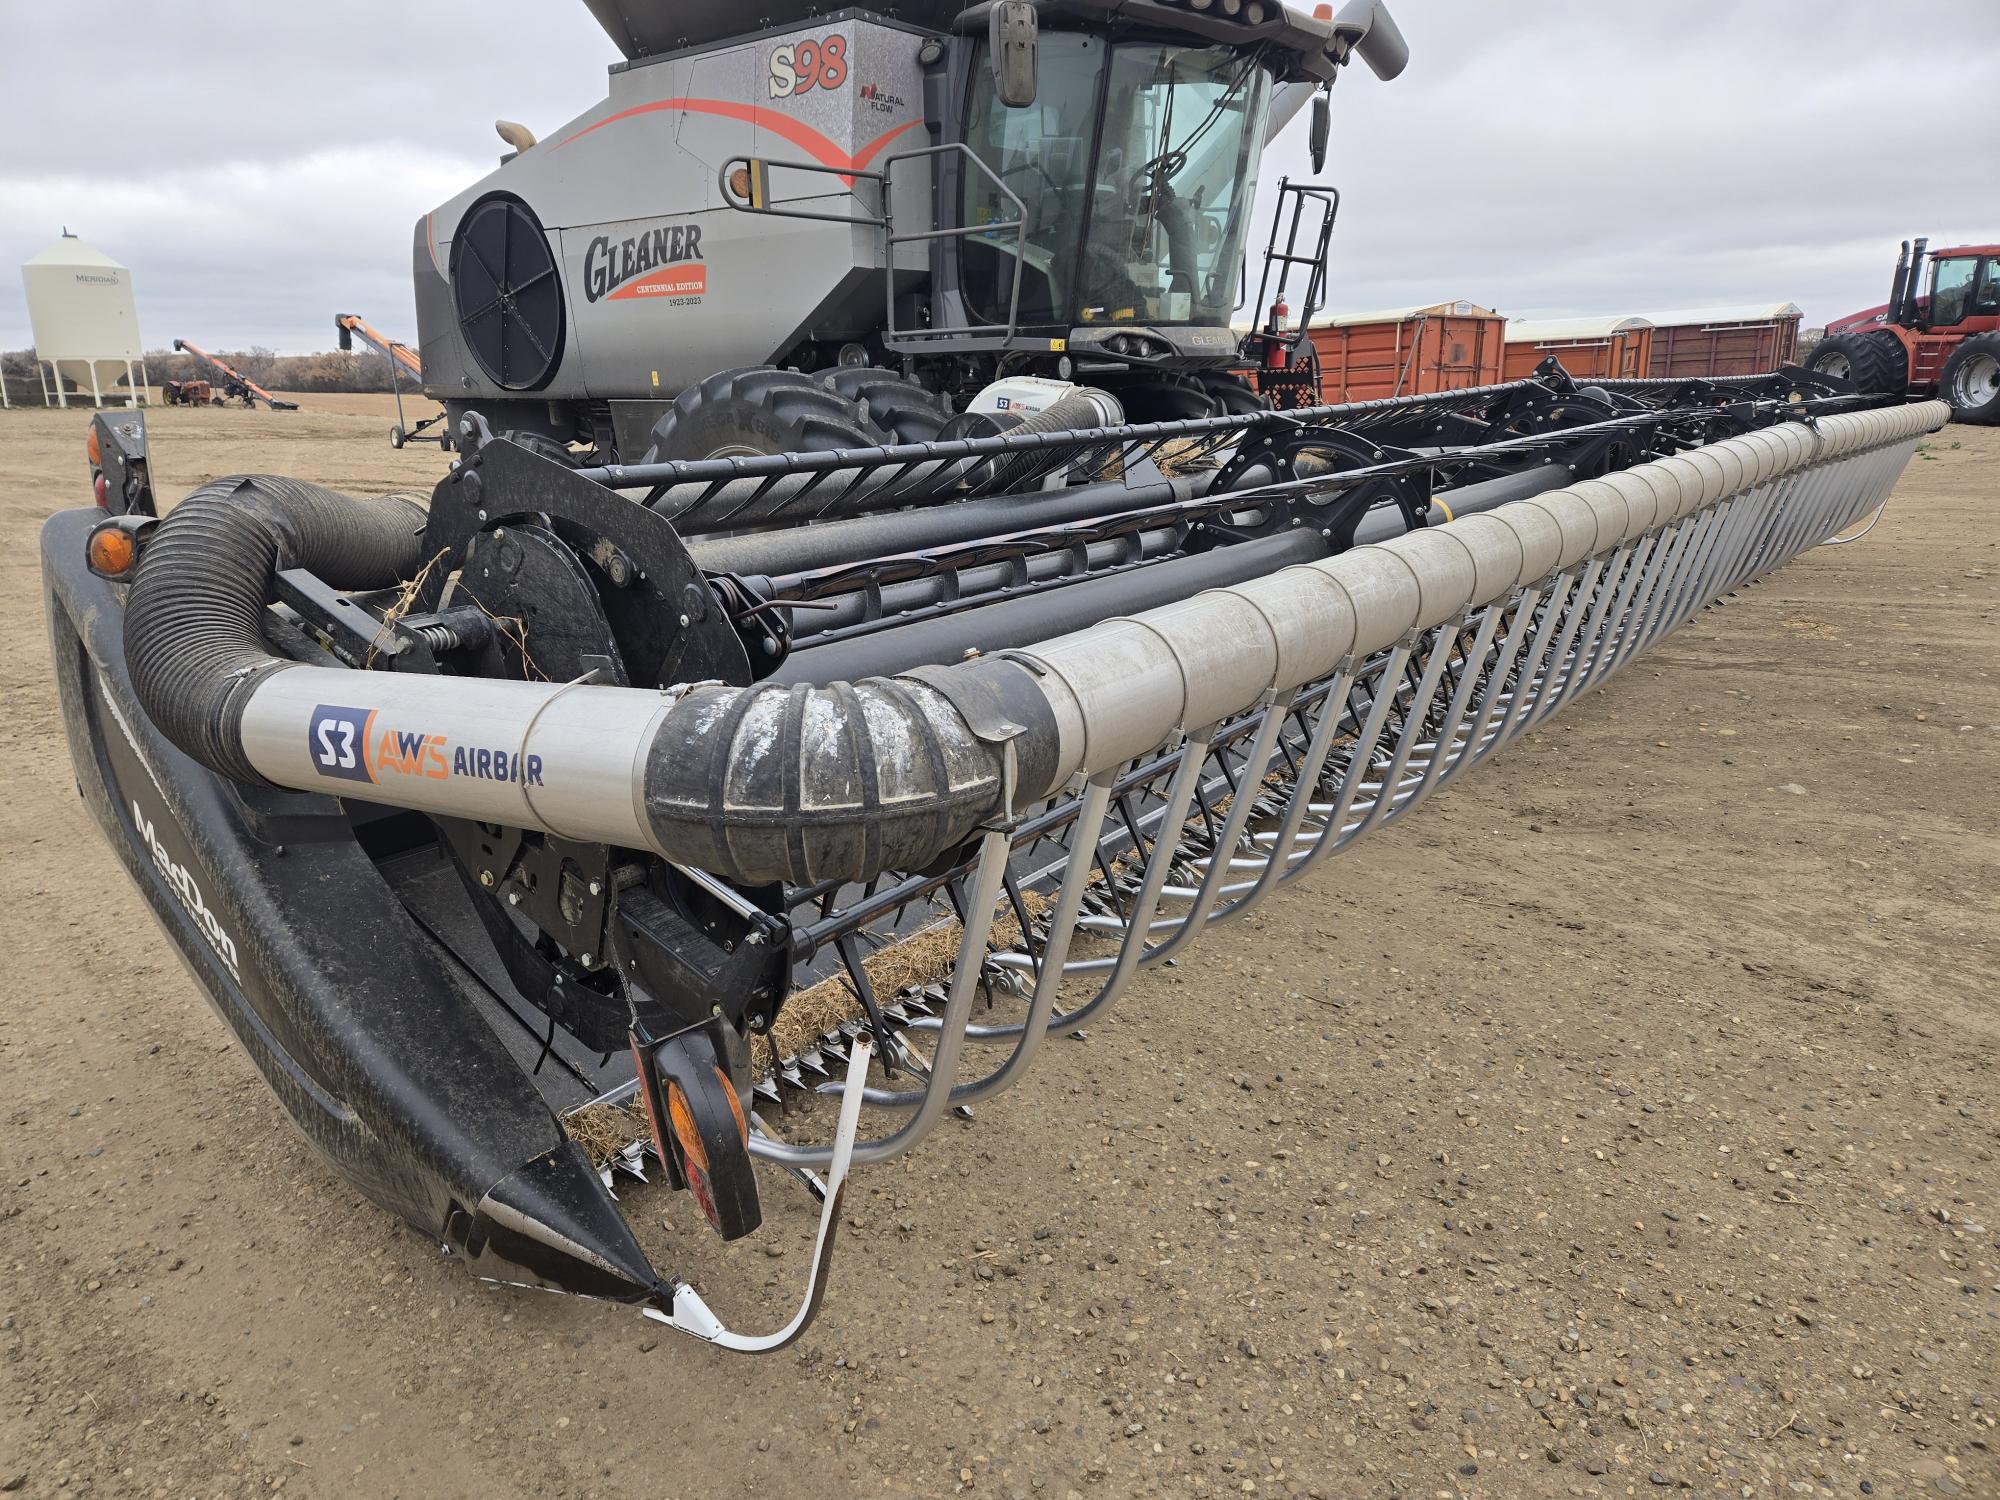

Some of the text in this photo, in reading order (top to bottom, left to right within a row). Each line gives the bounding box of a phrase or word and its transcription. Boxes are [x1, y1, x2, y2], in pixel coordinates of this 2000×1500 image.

[768, 34, 848, 99] S98
[860, 82, 905, 106] NATURAL
[871, 101, 894, 113] FLOW
[584, 224, 704, 303] GLEANER
[636, 281, 703, 294] CENTENNIAL EDITION
[669, 297, 702, 307] 1923-2023
[377, 730, 448, 780] AWS
[133, 800, 238, 968] MacDon
